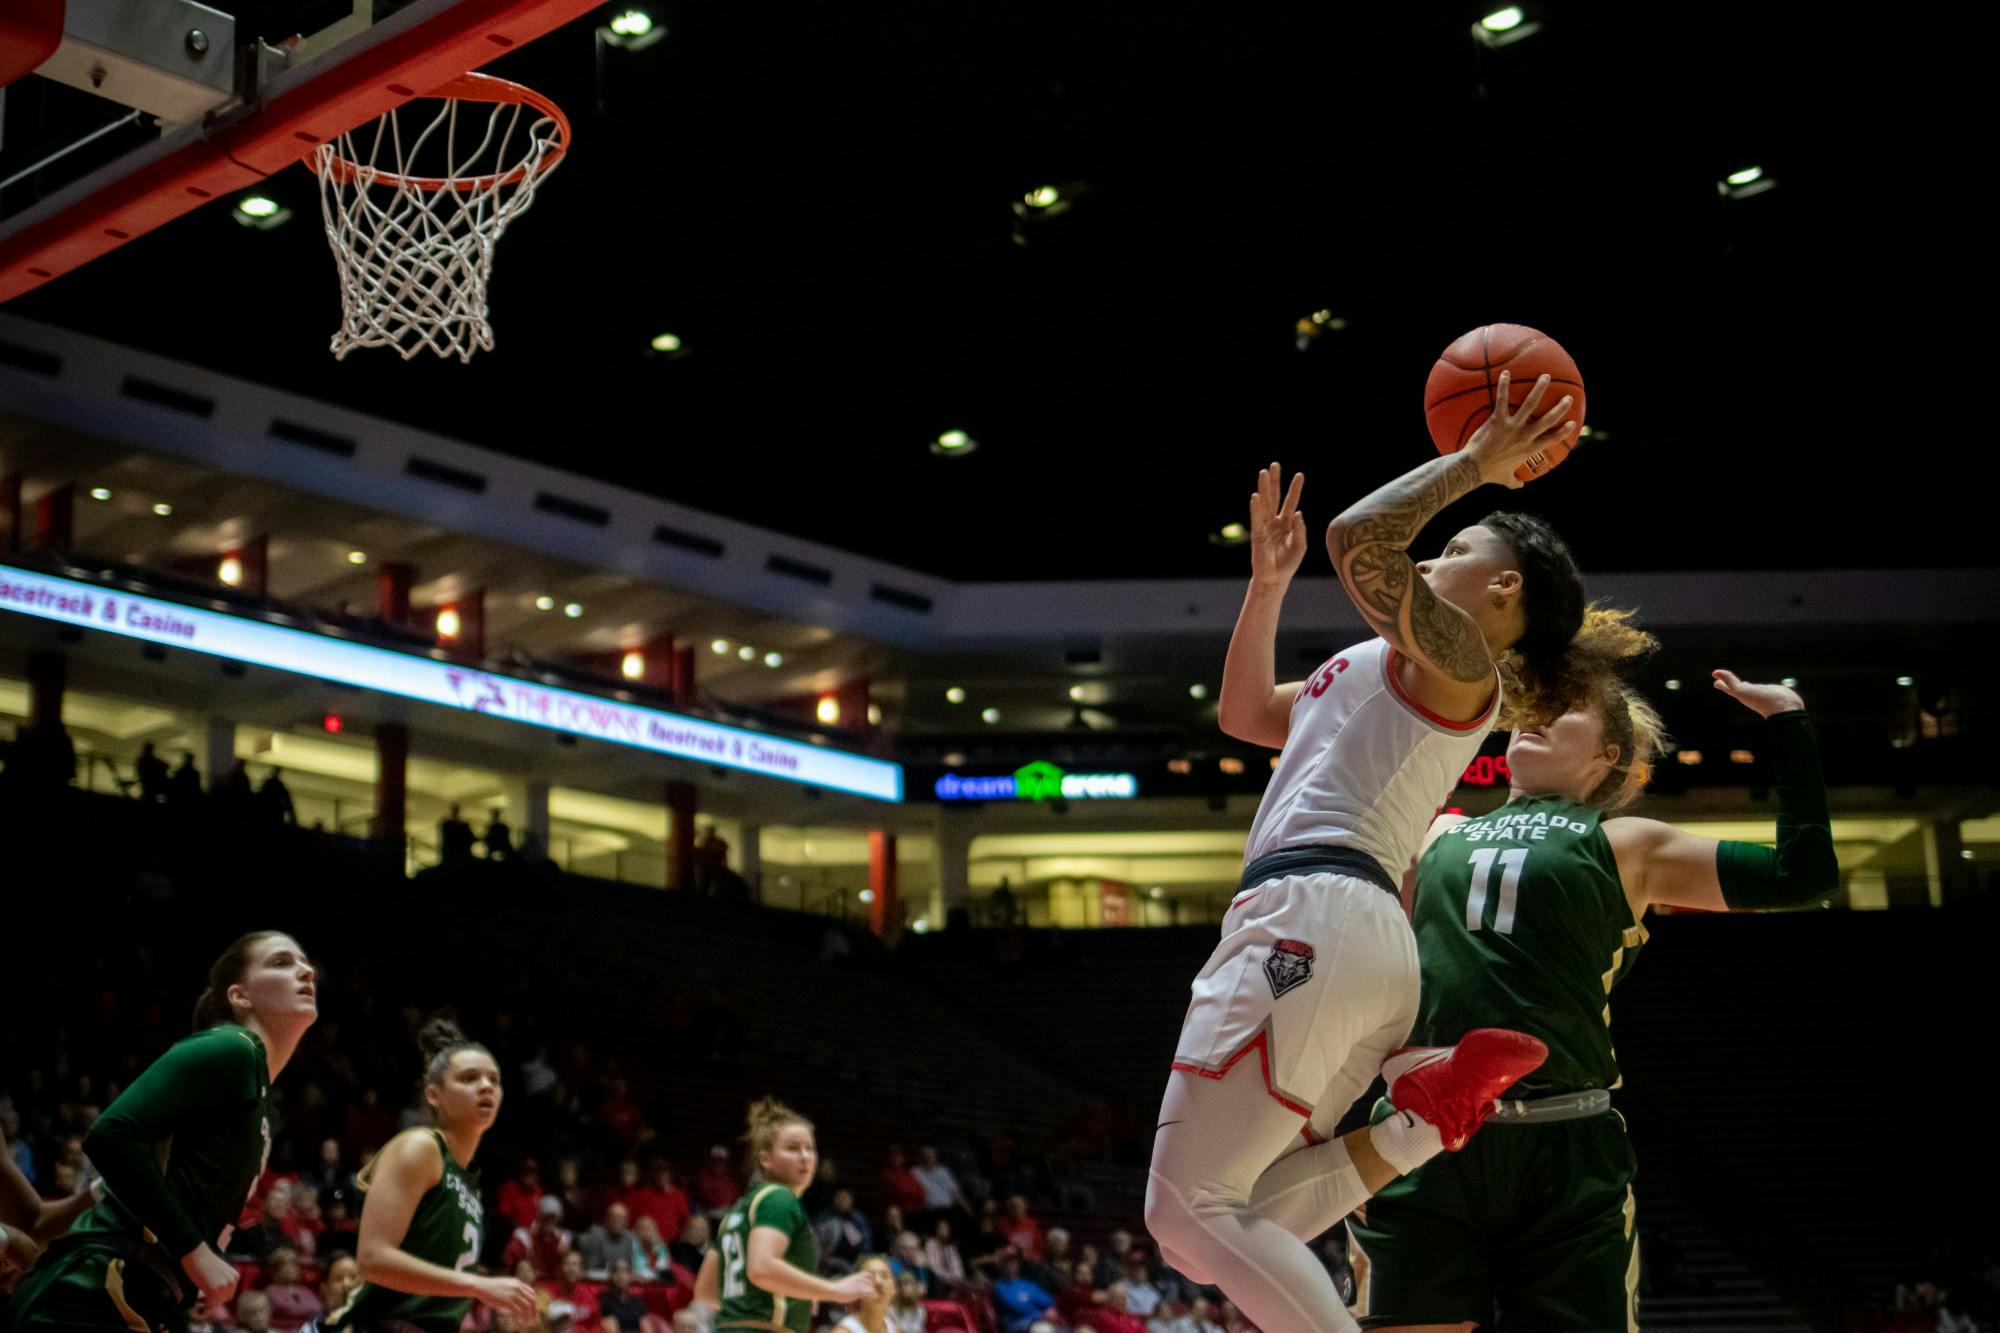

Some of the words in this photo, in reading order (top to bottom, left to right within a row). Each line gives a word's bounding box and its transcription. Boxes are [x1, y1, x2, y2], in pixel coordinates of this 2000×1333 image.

[0, 582, 93, 617] acetrack
[127, 602, 195, 637] Casino
[1447, 811, 1588, 835] COLORADO
[1466, 825, 1550, 841] STATE
[1466, 847, 1529, 934] 11
